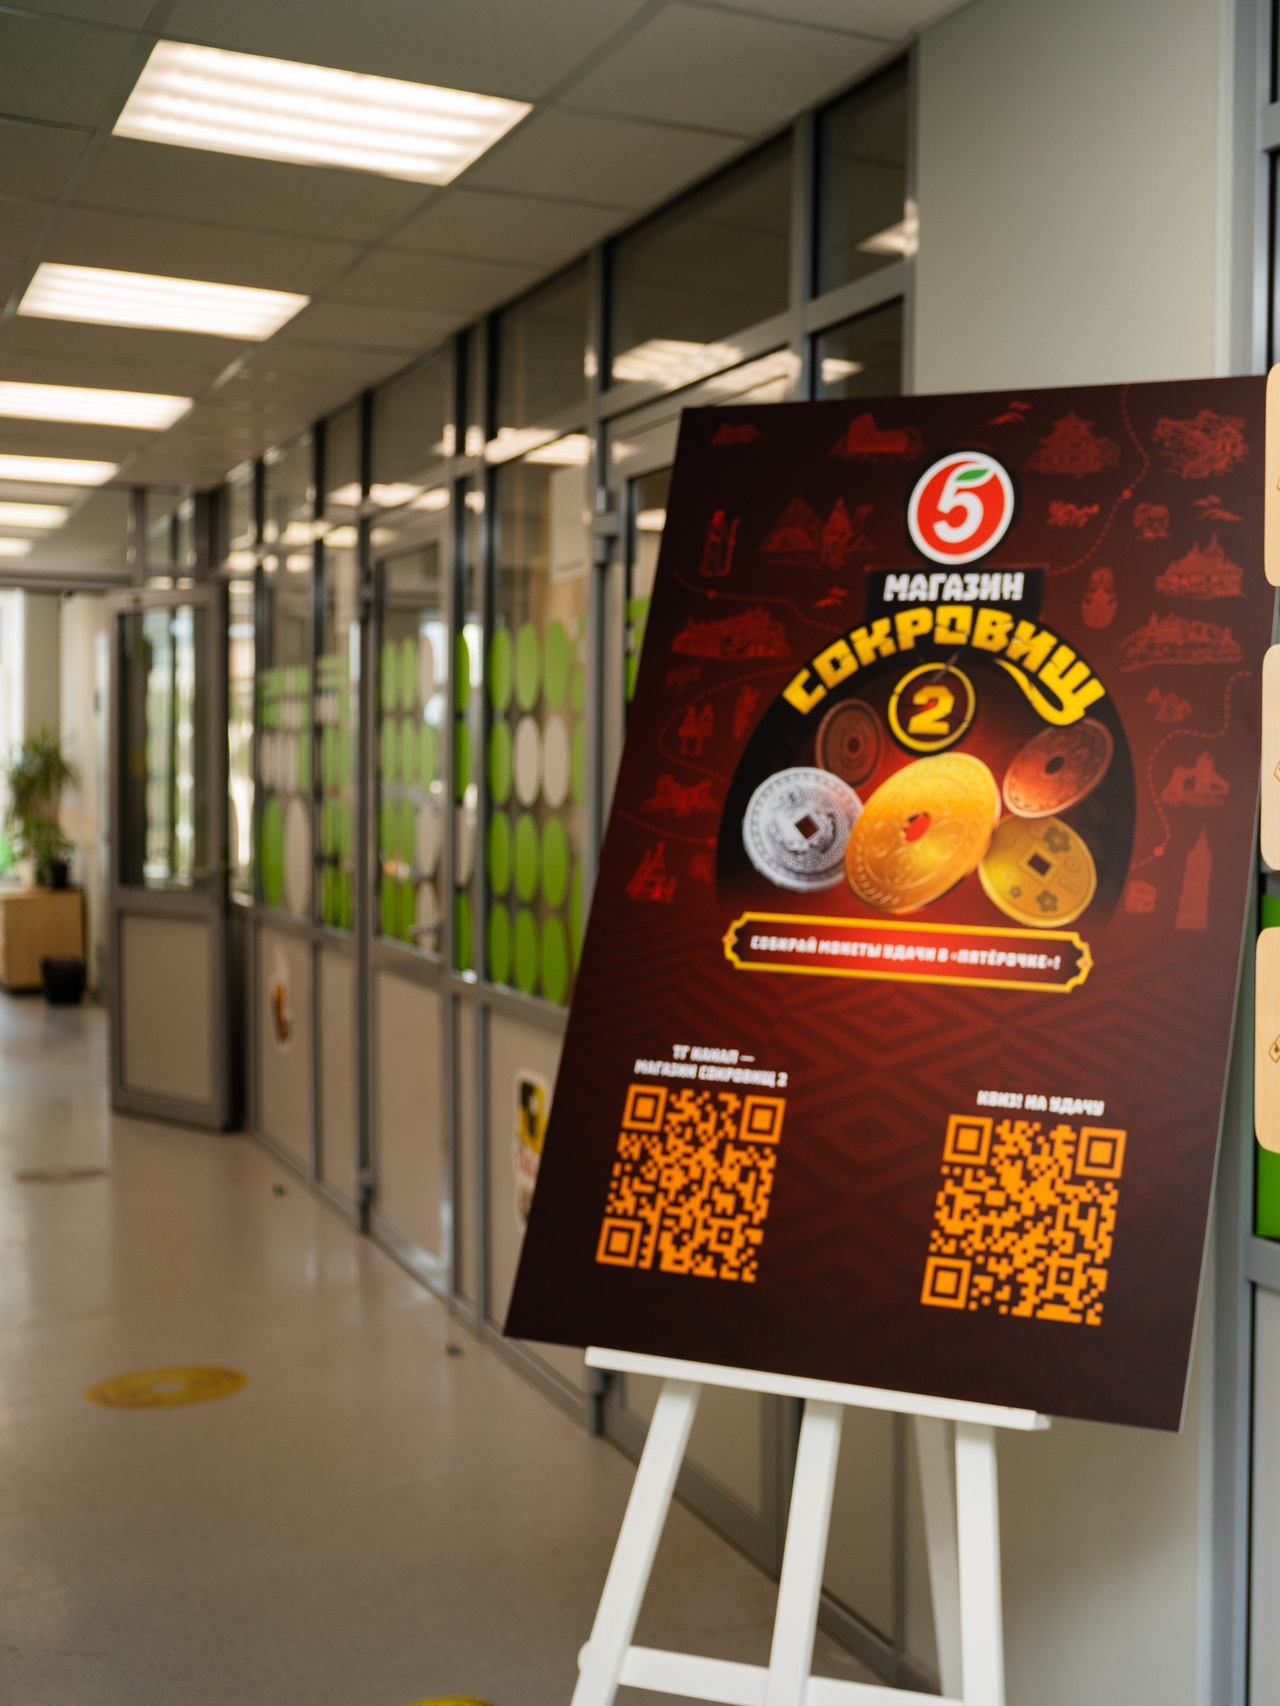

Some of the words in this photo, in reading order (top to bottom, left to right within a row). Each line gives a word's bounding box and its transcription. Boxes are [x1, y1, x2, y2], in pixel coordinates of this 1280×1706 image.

[933, 467, 994, 543] 5
[883, 571, 1025, 602] МАГАЗИН
[781, 604, 1106, 726] СОКРОВИЩ
[908, 684, 955, 735] 2
[750, 935, 818, 953] СОБИРАЙ
[818, 940, 882, 958] МОНЕТЫ
[882, 944, 936, 962] УДАЧИ
[937, 947, 949, 962] В
[672, 1044, 691, 1060] ТГ
[690, 1046, 739, 1065] КАНАЛ
[634, 1059, 698, 1079] МАГАЗИН
[698, 1065, 776, 1088] СОКРОВИЩ
[776, 1072, 788, 1088] 2
[1024, 1094, 1048, 1111] НА
[1048, 1096, 1105, 1116] УДАЧУ
